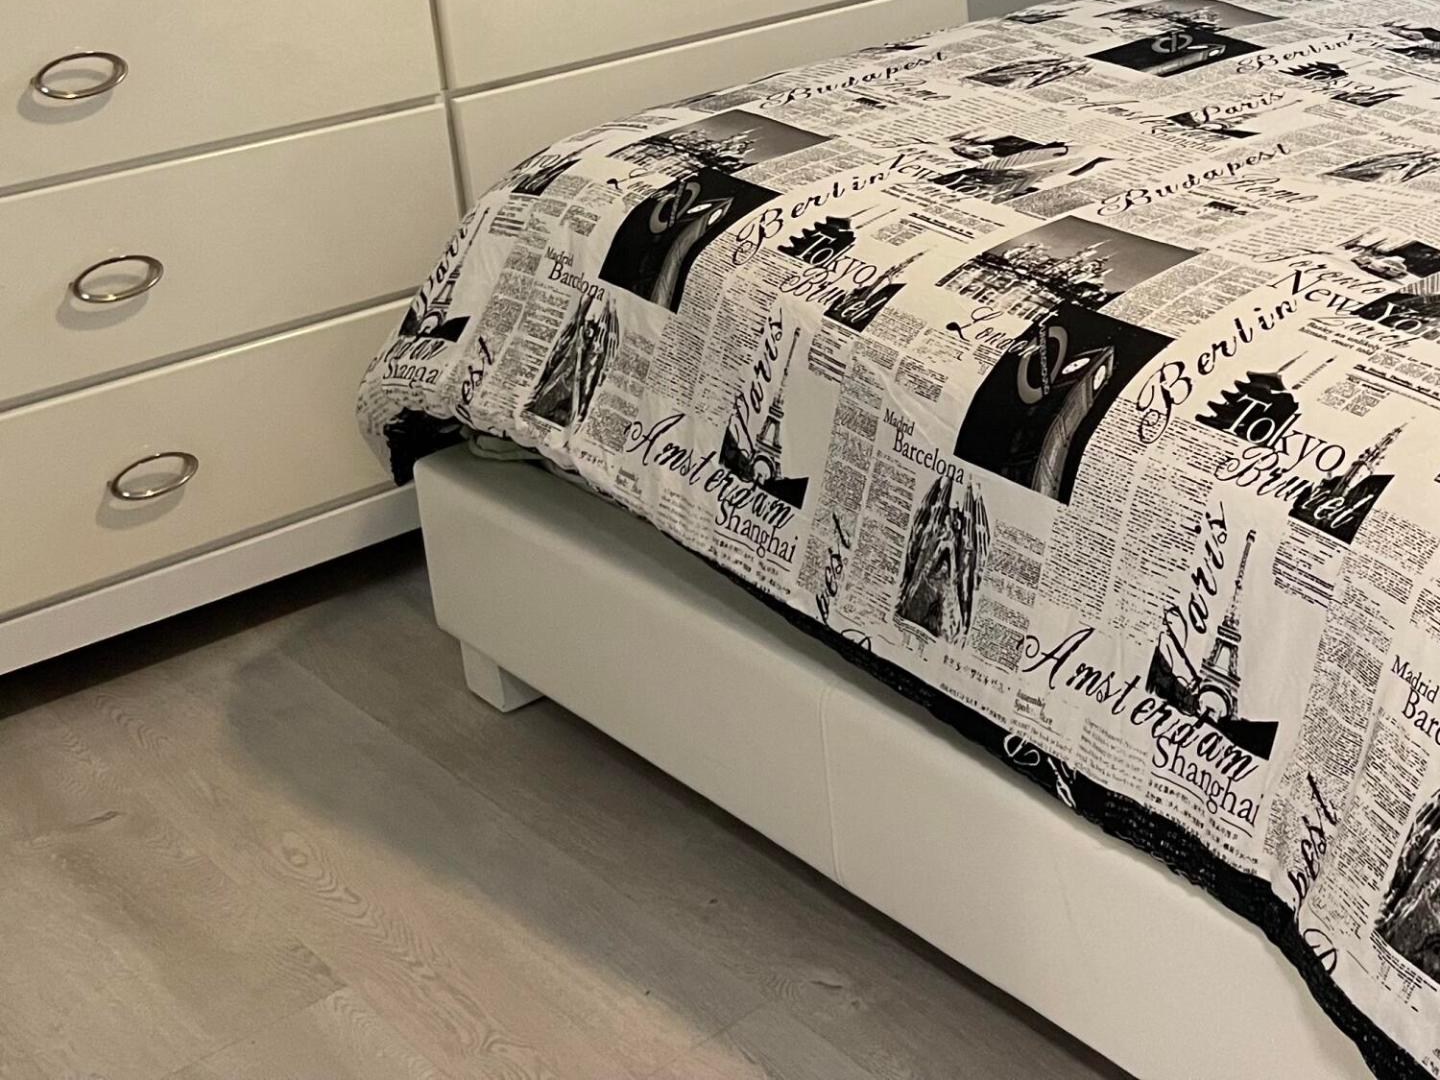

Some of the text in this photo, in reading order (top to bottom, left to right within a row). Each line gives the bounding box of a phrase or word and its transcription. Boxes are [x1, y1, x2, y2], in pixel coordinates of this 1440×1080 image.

[760, 51, 949, 110] Budapest
[1237, 40, 1352, 74] Berlin
[1191, 91, 1285, 124] Paris
[1097, 143, 1291, 217] Budapest
[732, 170, 889, 266] Berlin
[796, 230, 879, 284] Tokyo
[1252, 247, 1388, 295] Toronto
[1266, 269, 1366, 318] New
[730, 307, 783, 457] Paris
[1136, 295, 1302, 445] Berlin
[883, 408, 916, 437] Madrid
[1222, 393, 1347, 473] Tokyo
[623, 412, 797, 530] Amsterdam
[892, 430, 965, 485] Barcelona
[714, 499, 799, 563] Shanghai
[1158, 500, 1227, 698] Paris
[1015, 625, 1259, 783] Amsterdam
[1390, 654, 1440, 704] Madrid
[1151, 733, 1265, 827] Shanghai
